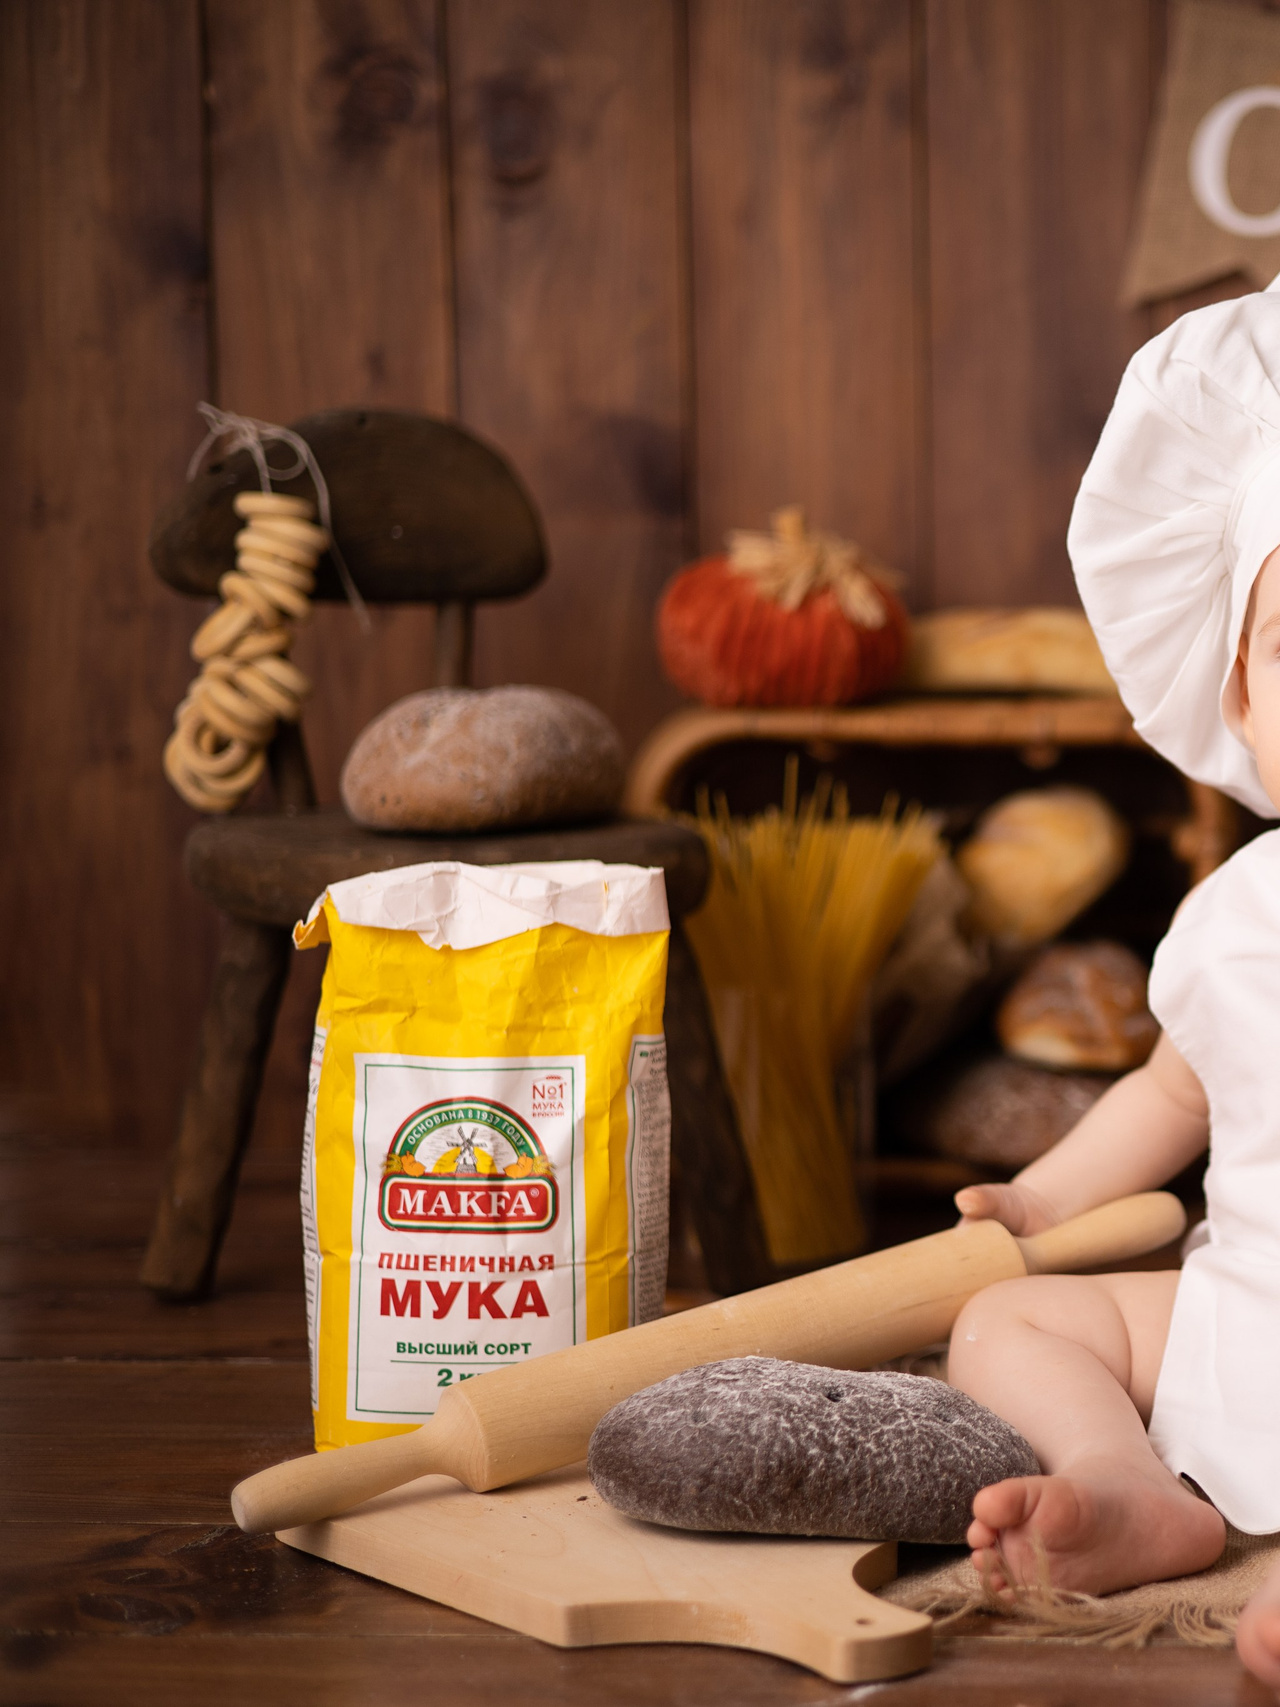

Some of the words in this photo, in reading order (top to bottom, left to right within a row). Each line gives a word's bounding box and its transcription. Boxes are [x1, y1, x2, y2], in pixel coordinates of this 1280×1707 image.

[532, 1102, 564, 1111] МУКА
[407, 1109, 465, 1146] ОСНОВАНА
[467, 1109, 474, 1119] В
[475, 1109, 501, 1124] 1937
[501, 1121, 526, 1147] ГОДУ
[396, 1188, 537, 1218] MAKFA
[378, 1252, 555, 1274] ПШЕНИЧНАЯ
[380, 1278, 550, 1320] МУКА
[396, 1340, 478, 1356] ВЫСШИЙ
[484, 1342, 532, 1356] СОРТ
[437, 1368, 453, 1387] 2
